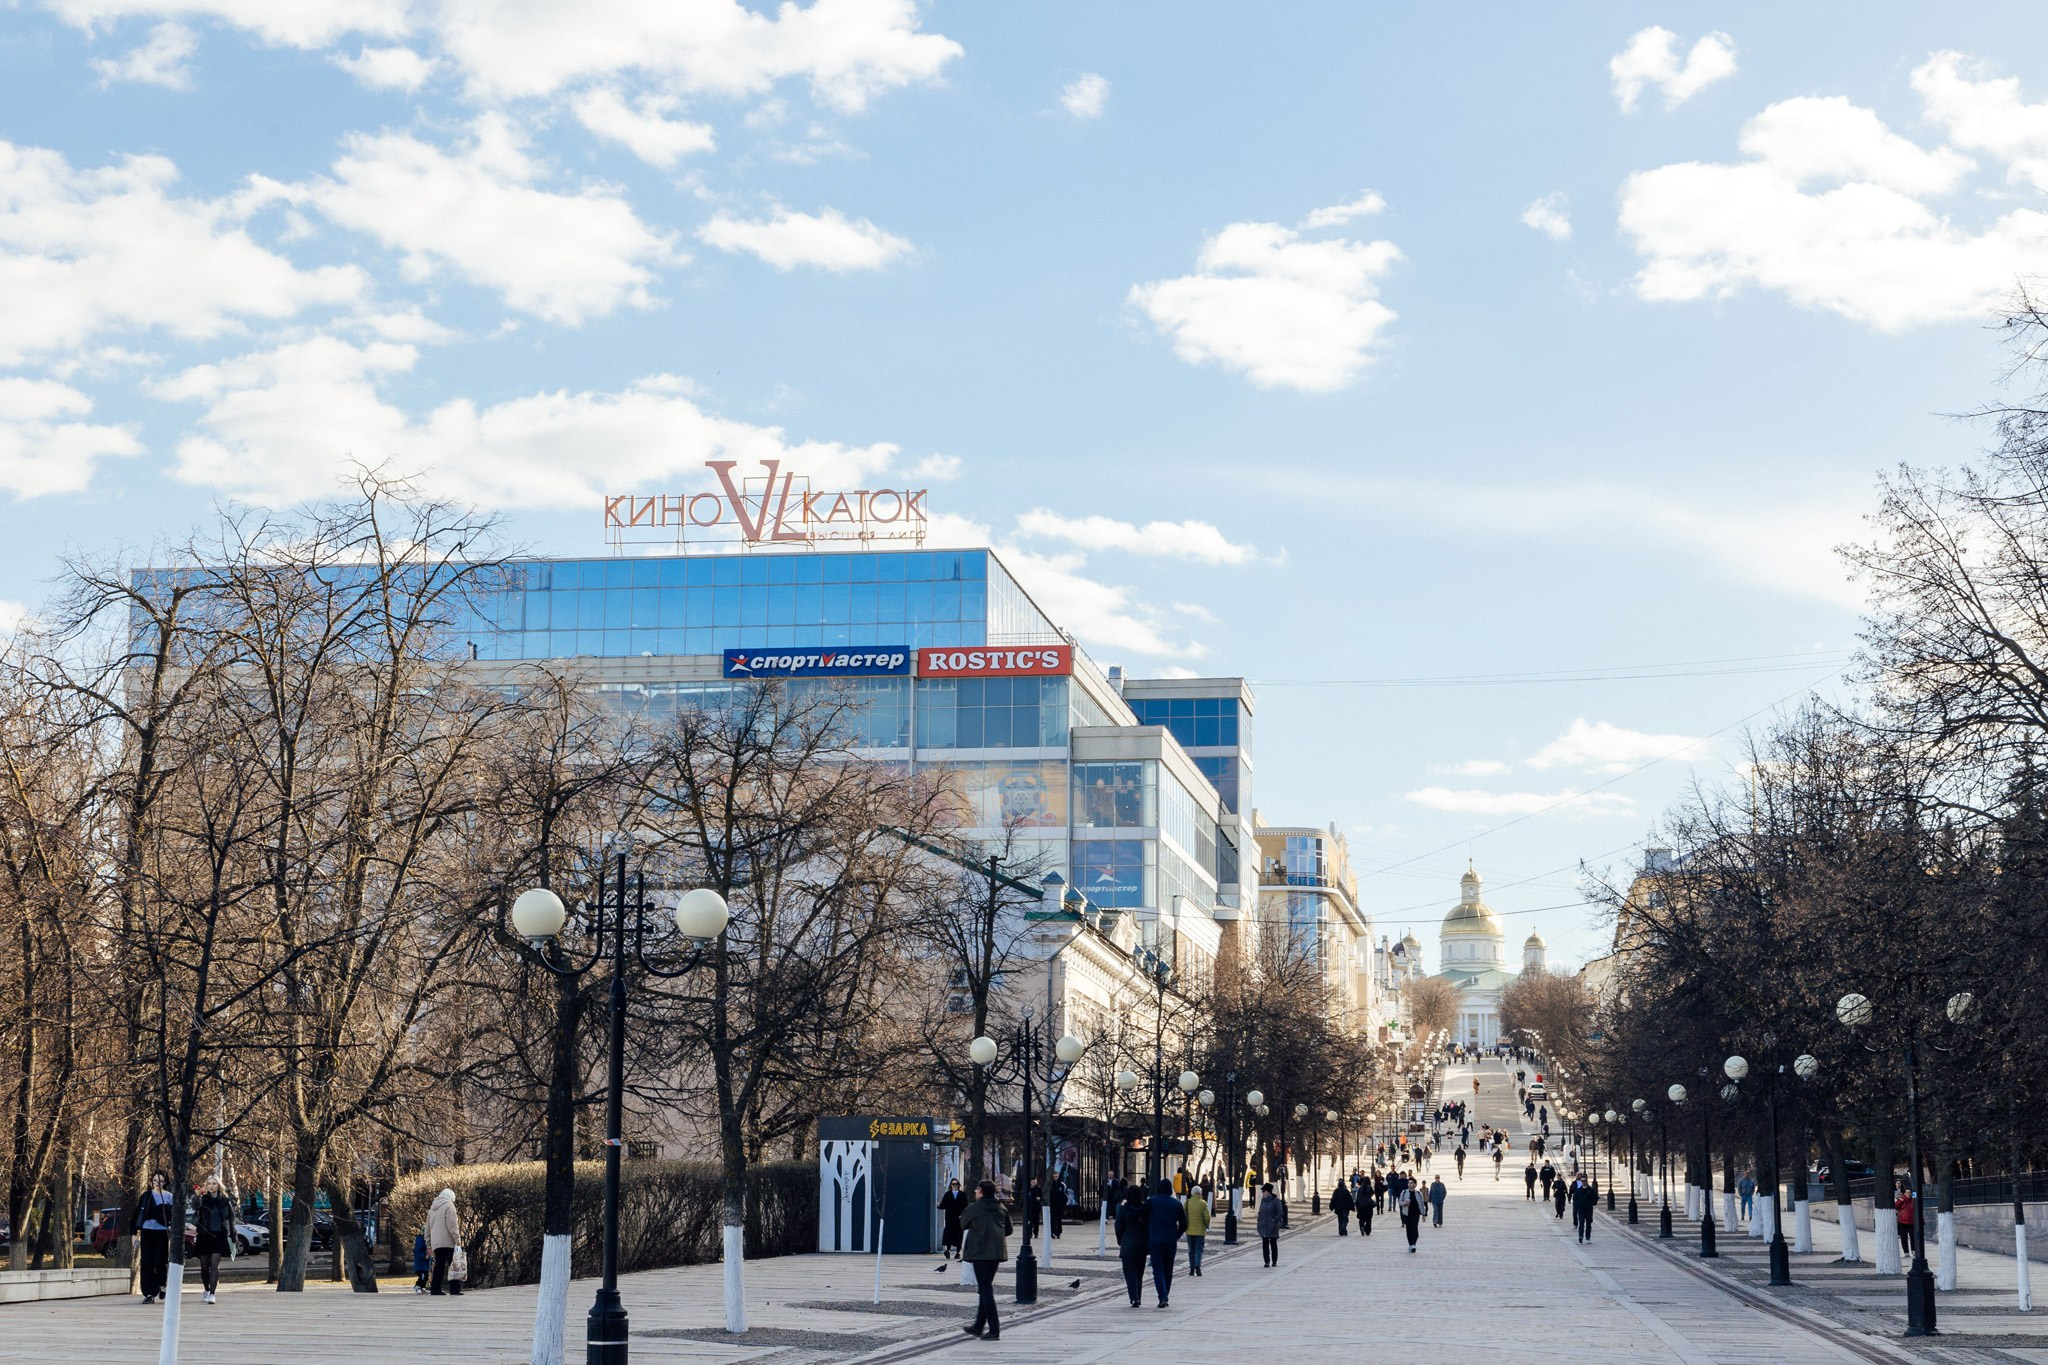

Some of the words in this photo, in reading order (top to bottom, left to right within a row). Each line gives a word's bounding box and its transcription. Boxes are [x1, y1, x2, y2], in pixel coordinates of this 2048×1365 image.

[605, 493, 723, 528] КИНО
[803, 489, 928, 523] КАТОК
[928, 651, 1060, 670] ROSTIC'S
